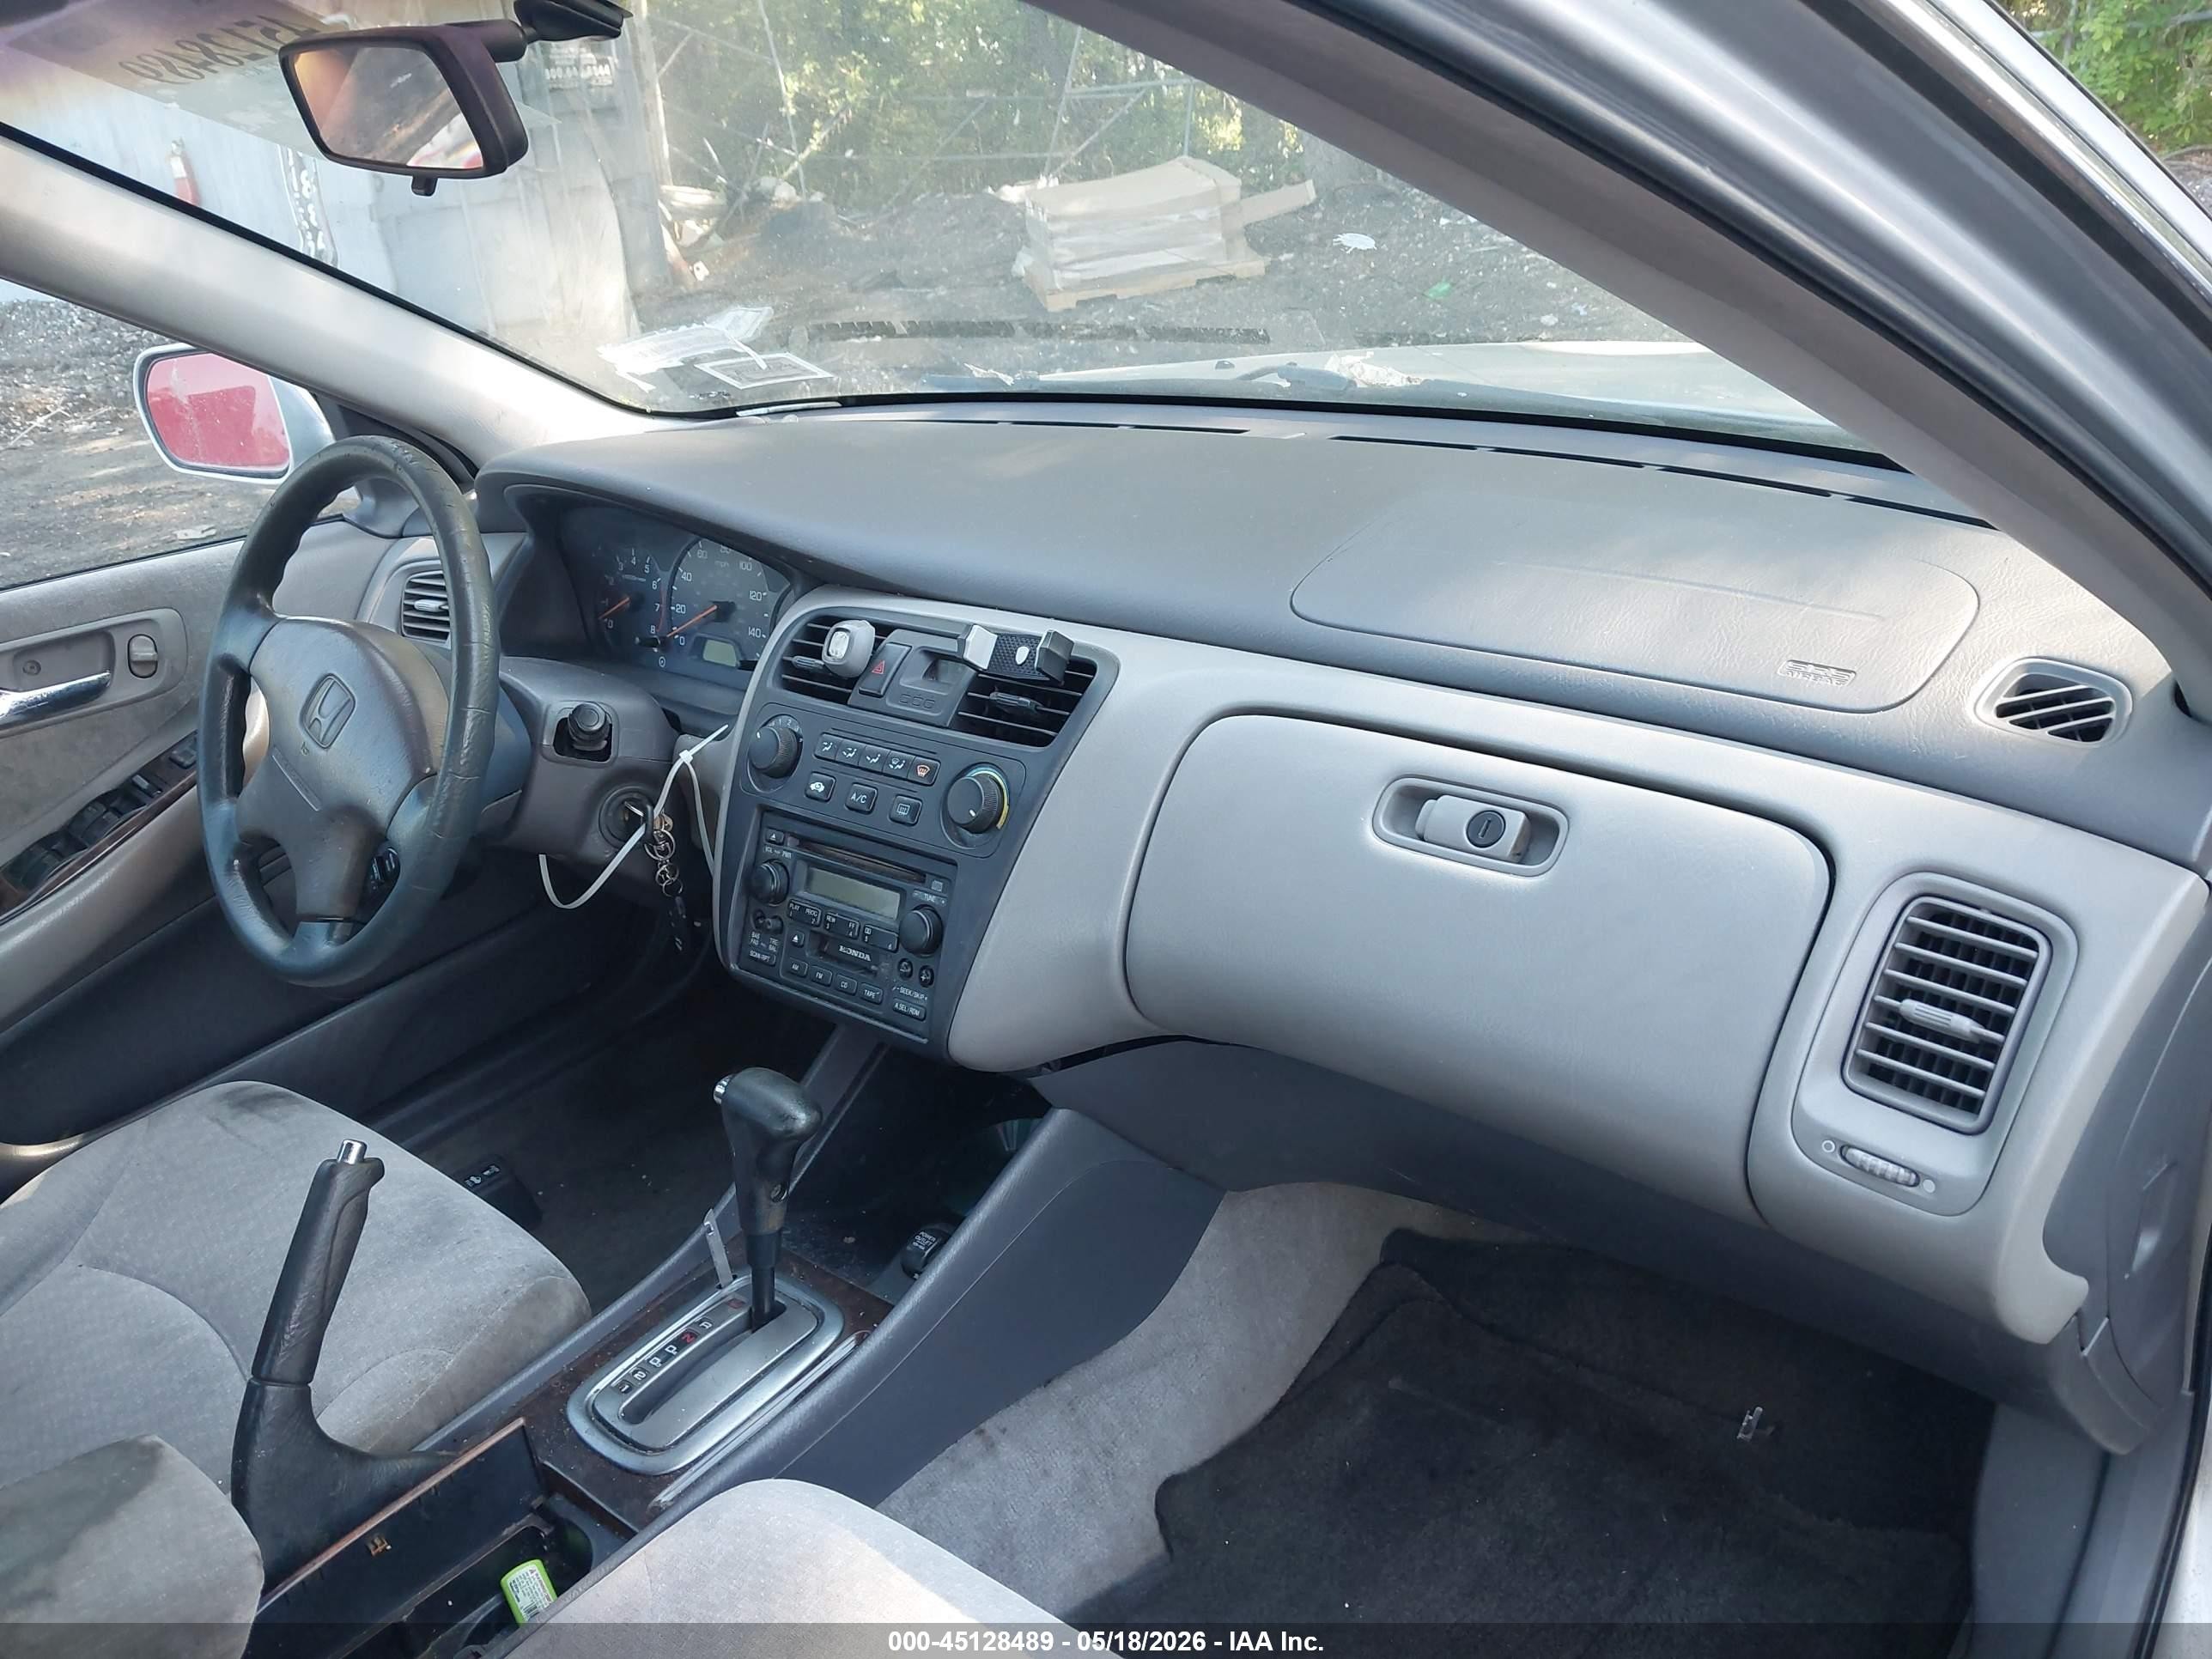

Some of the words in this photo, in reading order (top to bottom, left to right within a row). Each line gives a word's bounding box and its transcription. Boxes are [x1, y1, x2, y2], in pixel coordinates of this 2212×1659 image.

[645, 564, 650, 574] 5
[681, 571, 692, 581] 40
[652, 580, 658, 590] 6
[749, 590, 763, 601] 120
[654, 604, 660, 612] 7
[675, 604, 686, 614] 20
[650, 625, 656, 634] 8
[748, 628, 763, 638] 140
[679, 636, 685, 646] 0
[850, 790, 867, 804] A/C
[840, 981, 848, 989] CD
[864, 989, 877, 1000] TAPE
[681, 1334, 695, 1343] N
[635, 1371, 647, 1381] 2
